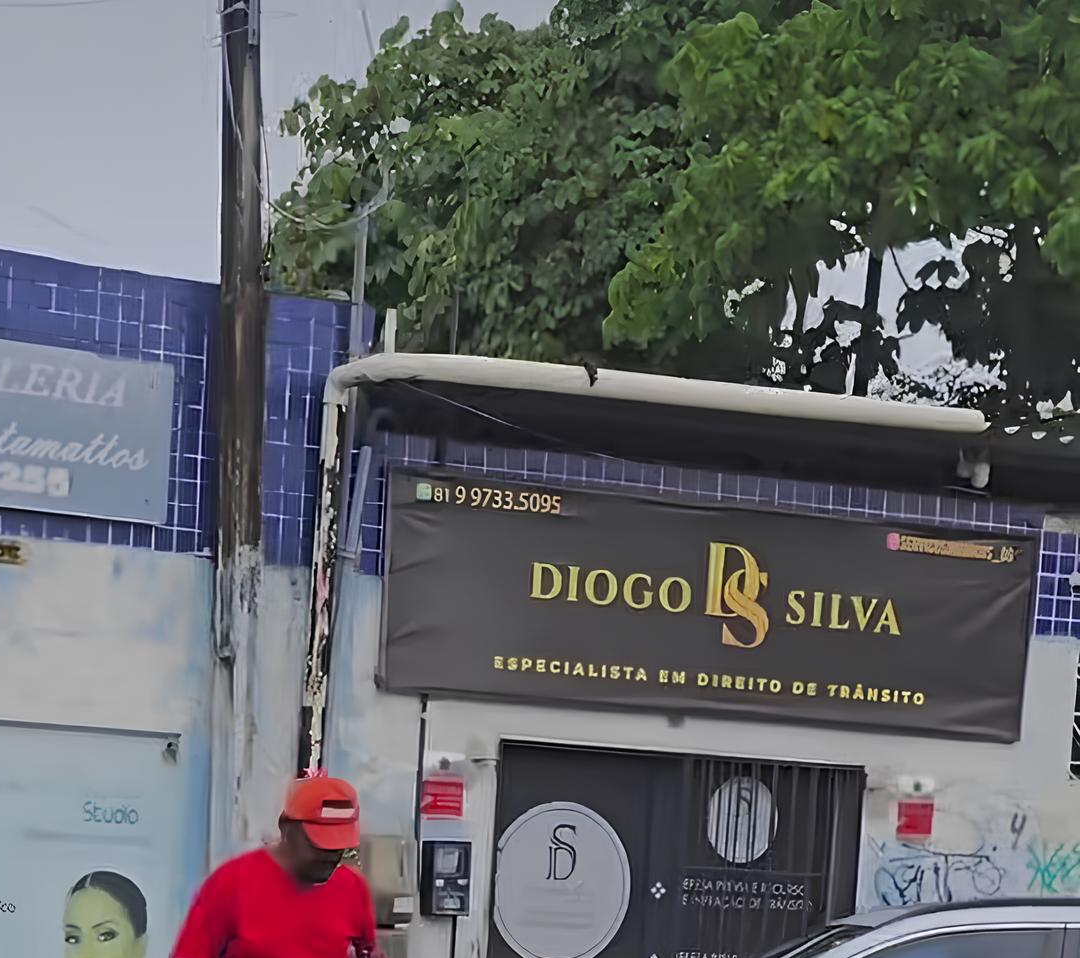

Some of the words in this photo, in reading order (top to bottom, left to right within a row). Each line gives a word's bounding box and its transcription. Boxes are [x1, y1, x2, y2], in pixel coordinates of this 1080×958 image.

[433, 487, 450, 503] 81
[455, 486, 466, 504] 9
[530, 561, 692, 613] DIOGO
[785, 590, 901, 636] SILVA
[494, 655, 648, 682] ESPECIALISTA
[658, 669, 686, 684] EM
[697, 672, 782, 694] DIREITO
[791, 680, 818, 697] DE
[827, 683, 925, 706] TRÂNSITO
